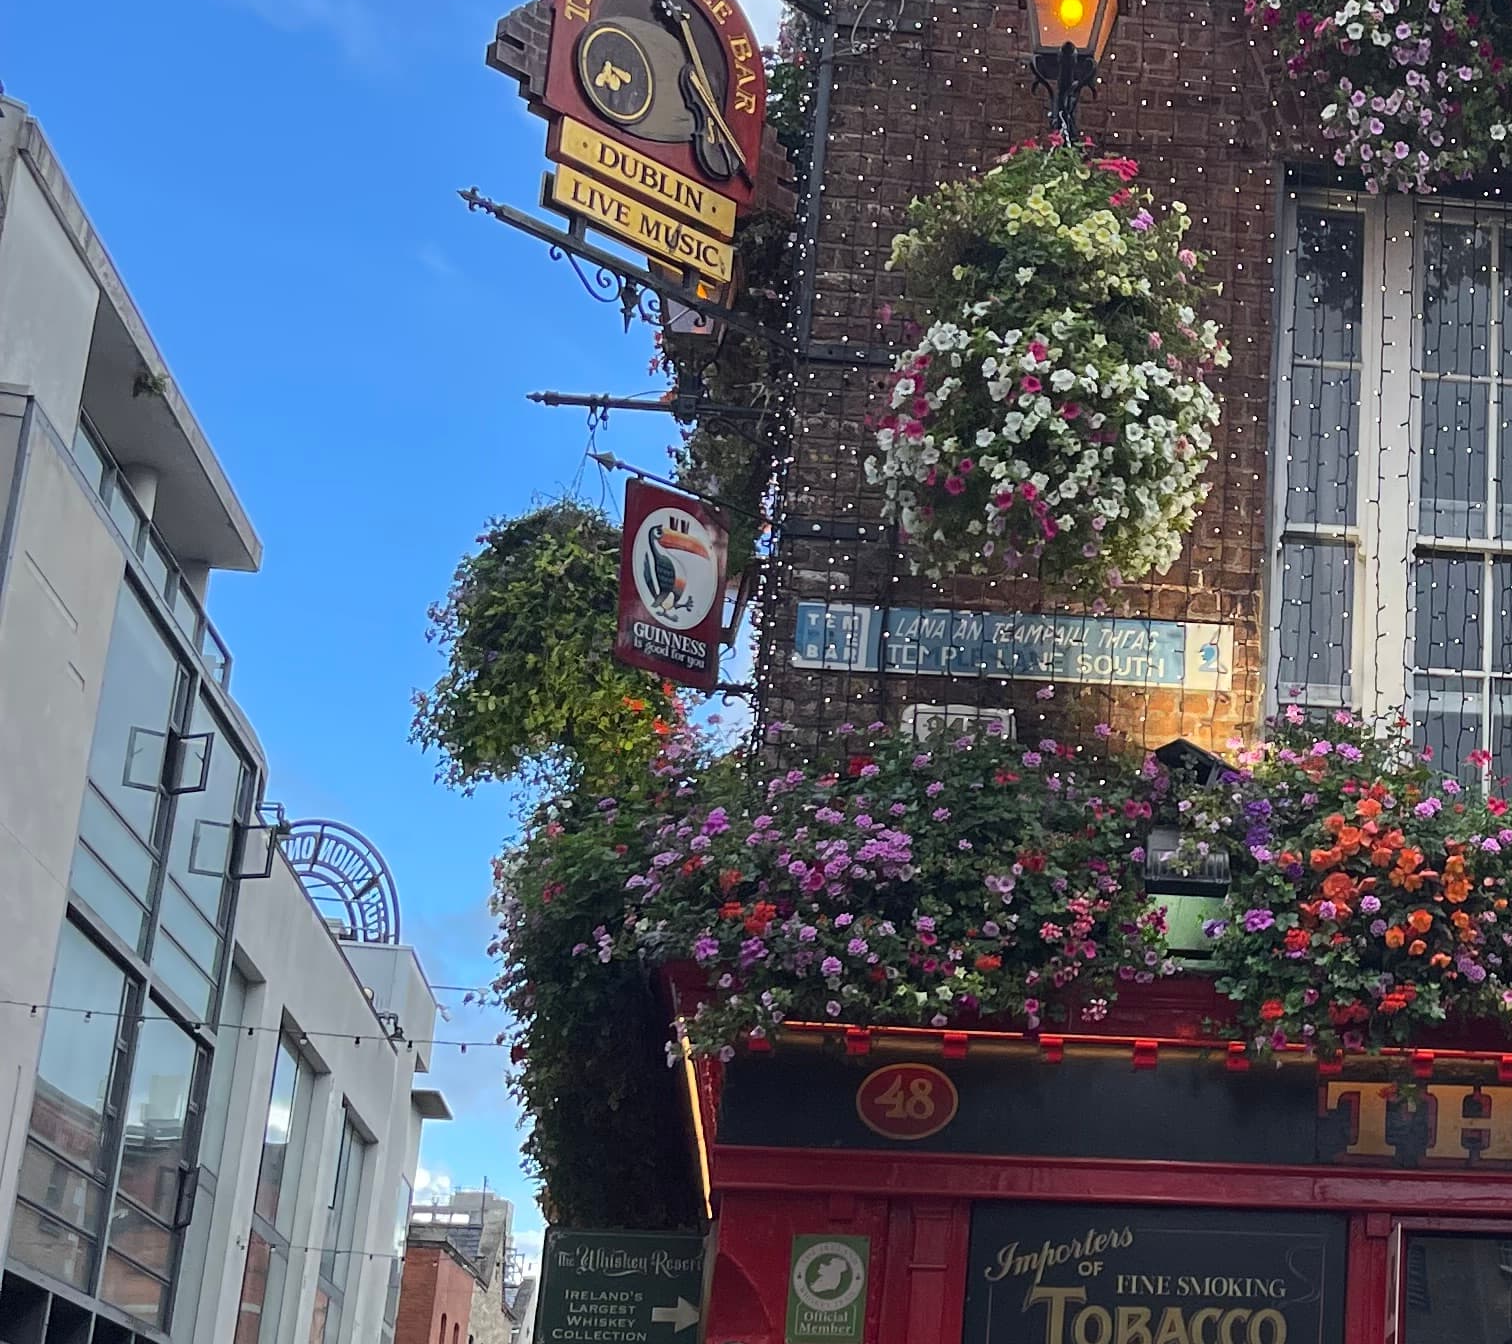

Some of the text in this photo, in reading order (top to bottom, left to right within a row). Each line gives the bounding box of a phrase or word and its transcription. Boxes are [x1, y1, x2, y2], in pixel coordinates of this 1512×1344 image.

[728, 33, 757, 115] BAR
[597, 142, 704, 215] DUBLIN
[571, 178, 720, 268] LIVE MUSIC
[634, 622, 706, 657] GUINNESS
[895, 617, 945, 641] LANA
[953, 619, 982, 641] AN
[644, 641, 669, 657] good
[671, 648, 686, 662] for
[687, 656, 705, 668] you
[1076, 654, 1165, 678] SOUTH
[874, 1075, 935, 1120] 48
[558, 1251, 575, 1268] The
[576, 1244, 648, 1277] Whiskey
[984, 1225, 1134, 1308] Importers
[1078, 1261, 1105, 1278] OF
[565, 1289, 643, 1302] IRELAND'S
[1115, 1274, 1288, 1299] FINE SMOKING
[569, 1302, 636, 1315] LARGEST
[804, 1311, 848, 1323] Official
[567, 1315, 637, 1329] WHISKEY
[799, 1322, 852, 1335] Member
[552, 1328, 647, 1342] COLLECTION
